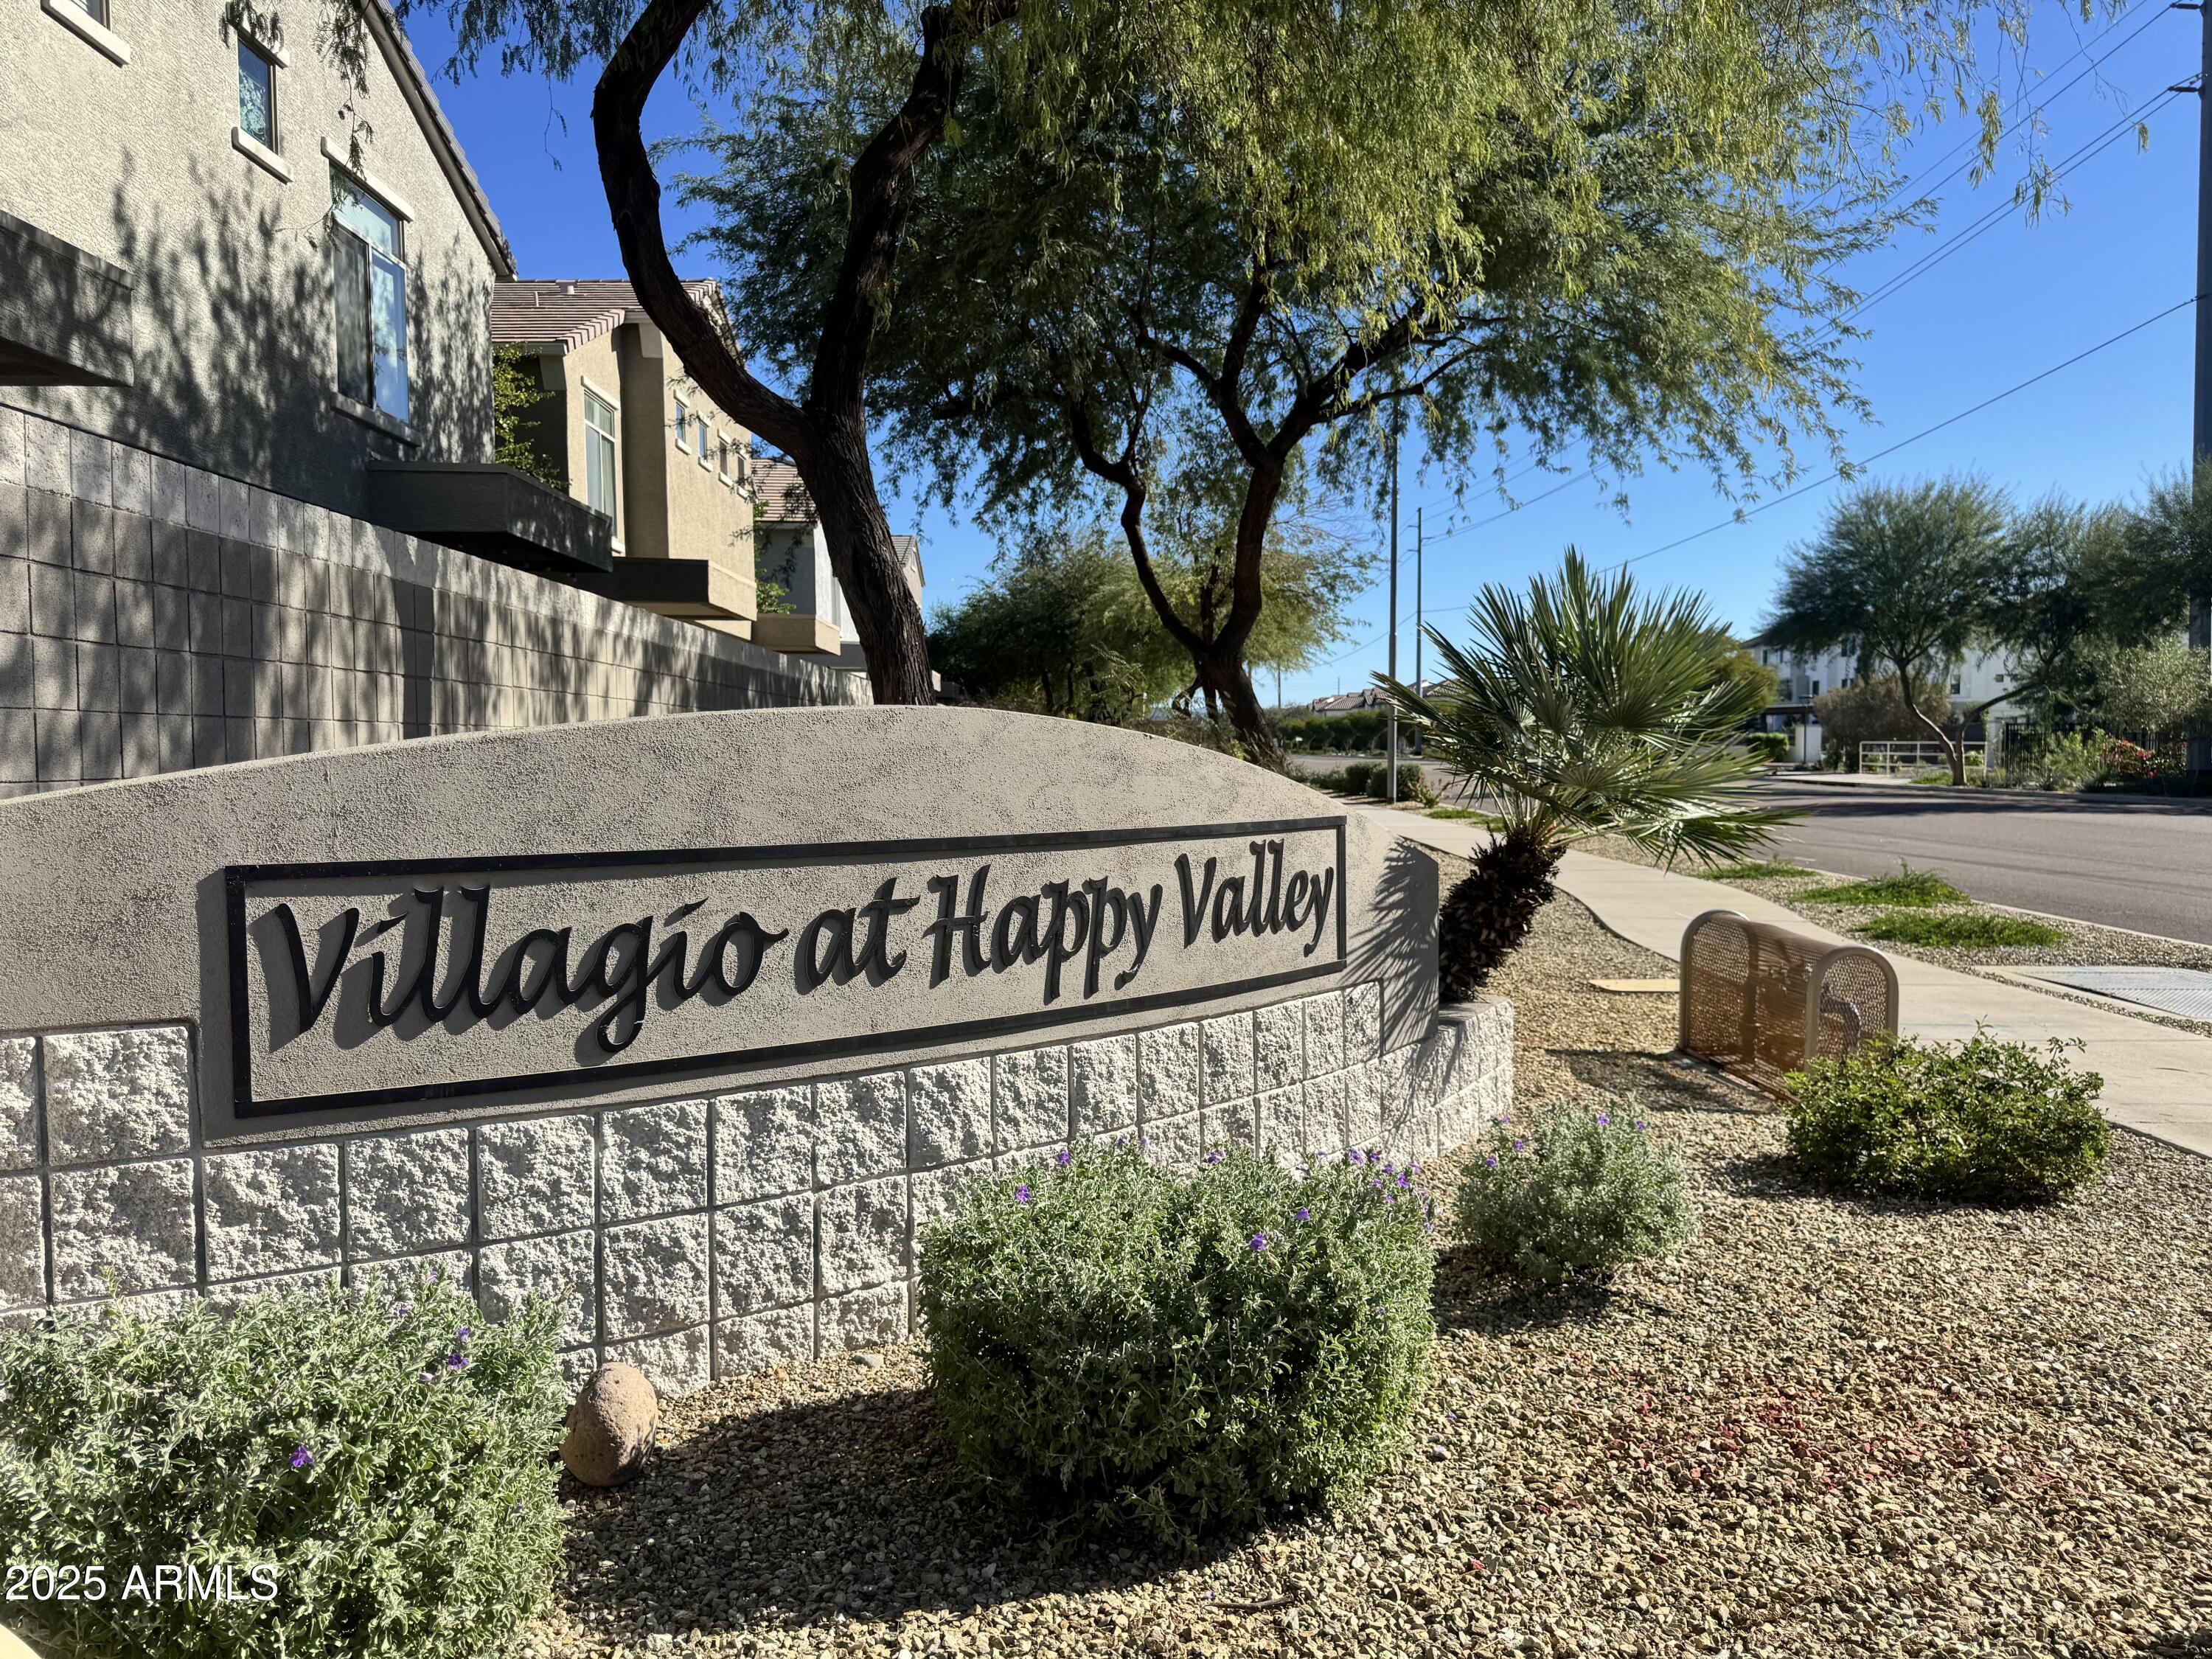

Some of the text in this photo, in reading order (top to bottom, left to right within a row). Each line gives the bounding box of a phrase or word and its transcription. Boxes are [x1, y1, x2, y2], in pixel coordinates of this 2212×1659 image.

[274, 838, 1335, 1053] Villagio at Happy Valley
